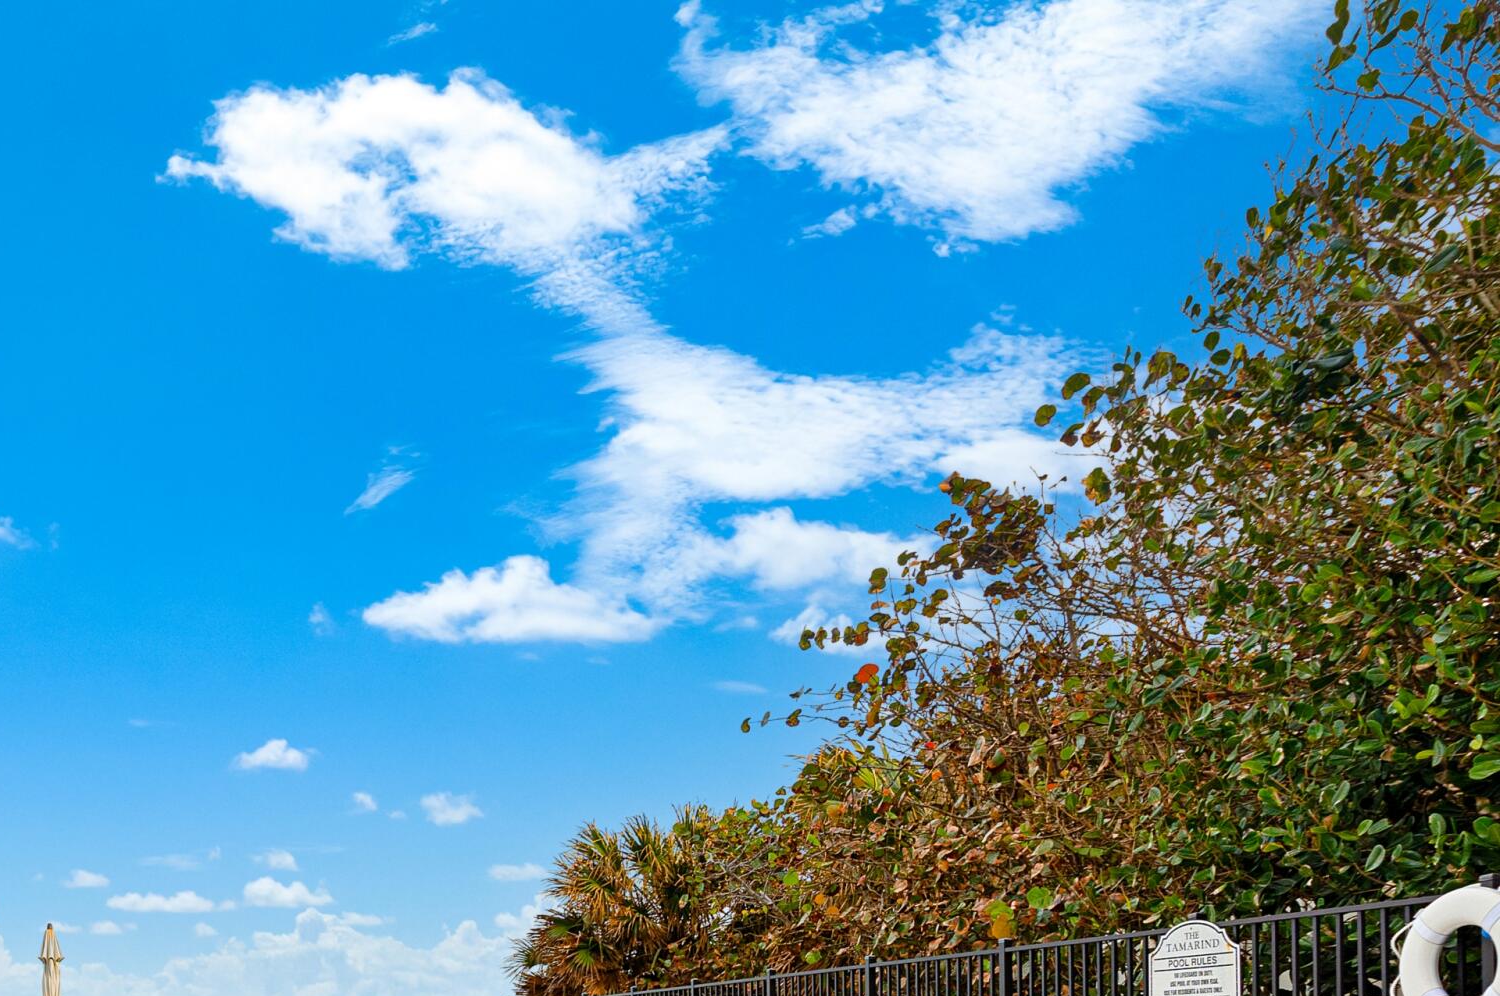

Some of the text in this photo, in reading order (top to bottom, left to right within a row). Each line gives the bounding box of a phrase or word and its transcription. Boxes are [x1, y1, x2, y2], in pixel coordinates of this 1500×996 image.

[1184, 931, 1200, 940] THE
[1166, 938, 1220, 953] TAMARIND
[1168, 956, 1218, 968] POOL RULES
